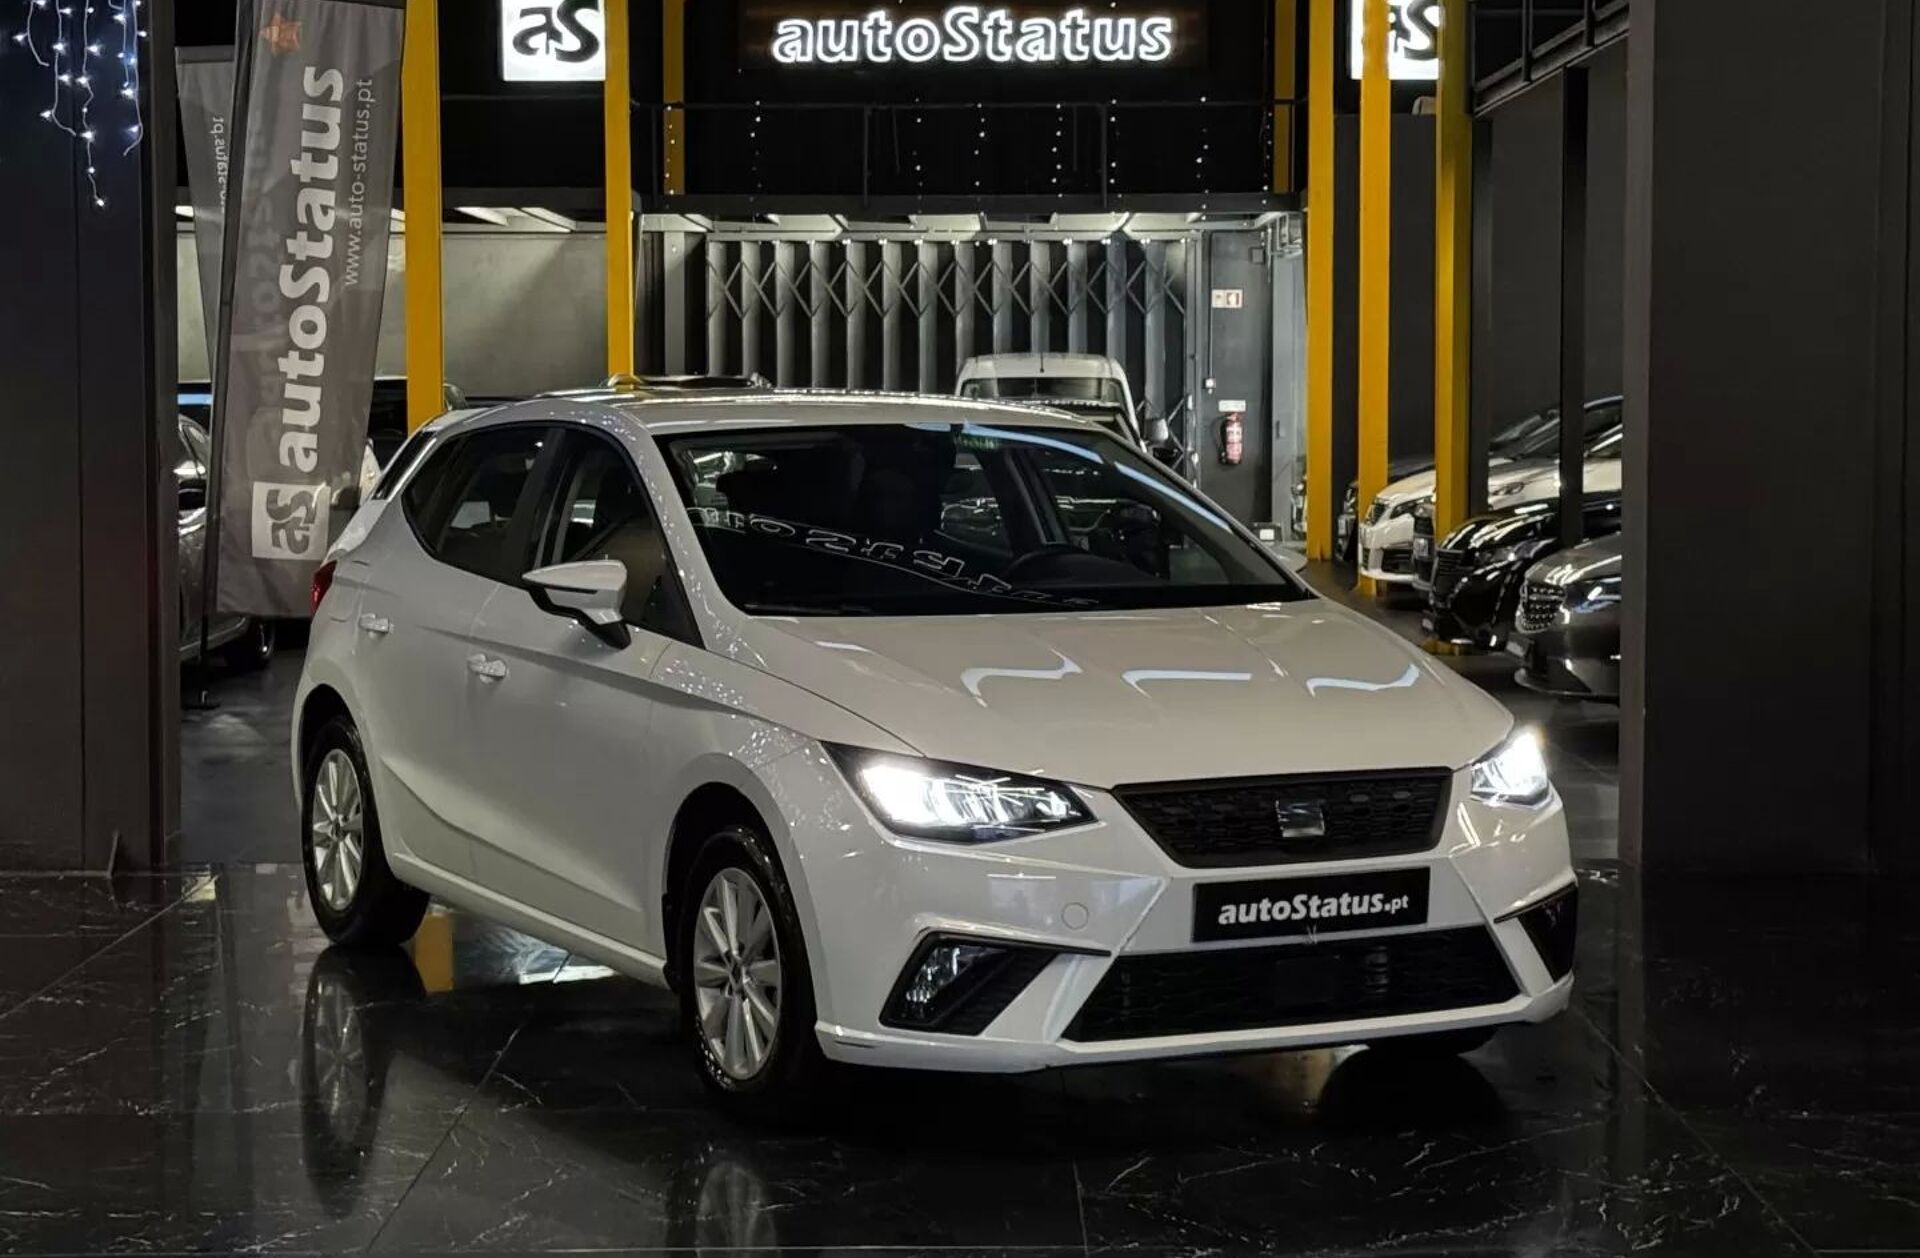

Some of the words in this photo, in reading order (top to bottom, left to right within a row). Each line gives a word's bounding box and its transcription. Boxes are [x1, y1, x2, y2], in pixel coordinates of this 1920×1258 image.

[772, 6, 1173, 63] autoStatus
[345, 79, 376, 287] www.auto-status.pt
[279, 66, 344, 473] autoStatus
[1218, 892, 1409, 925] autoStatus.pt
